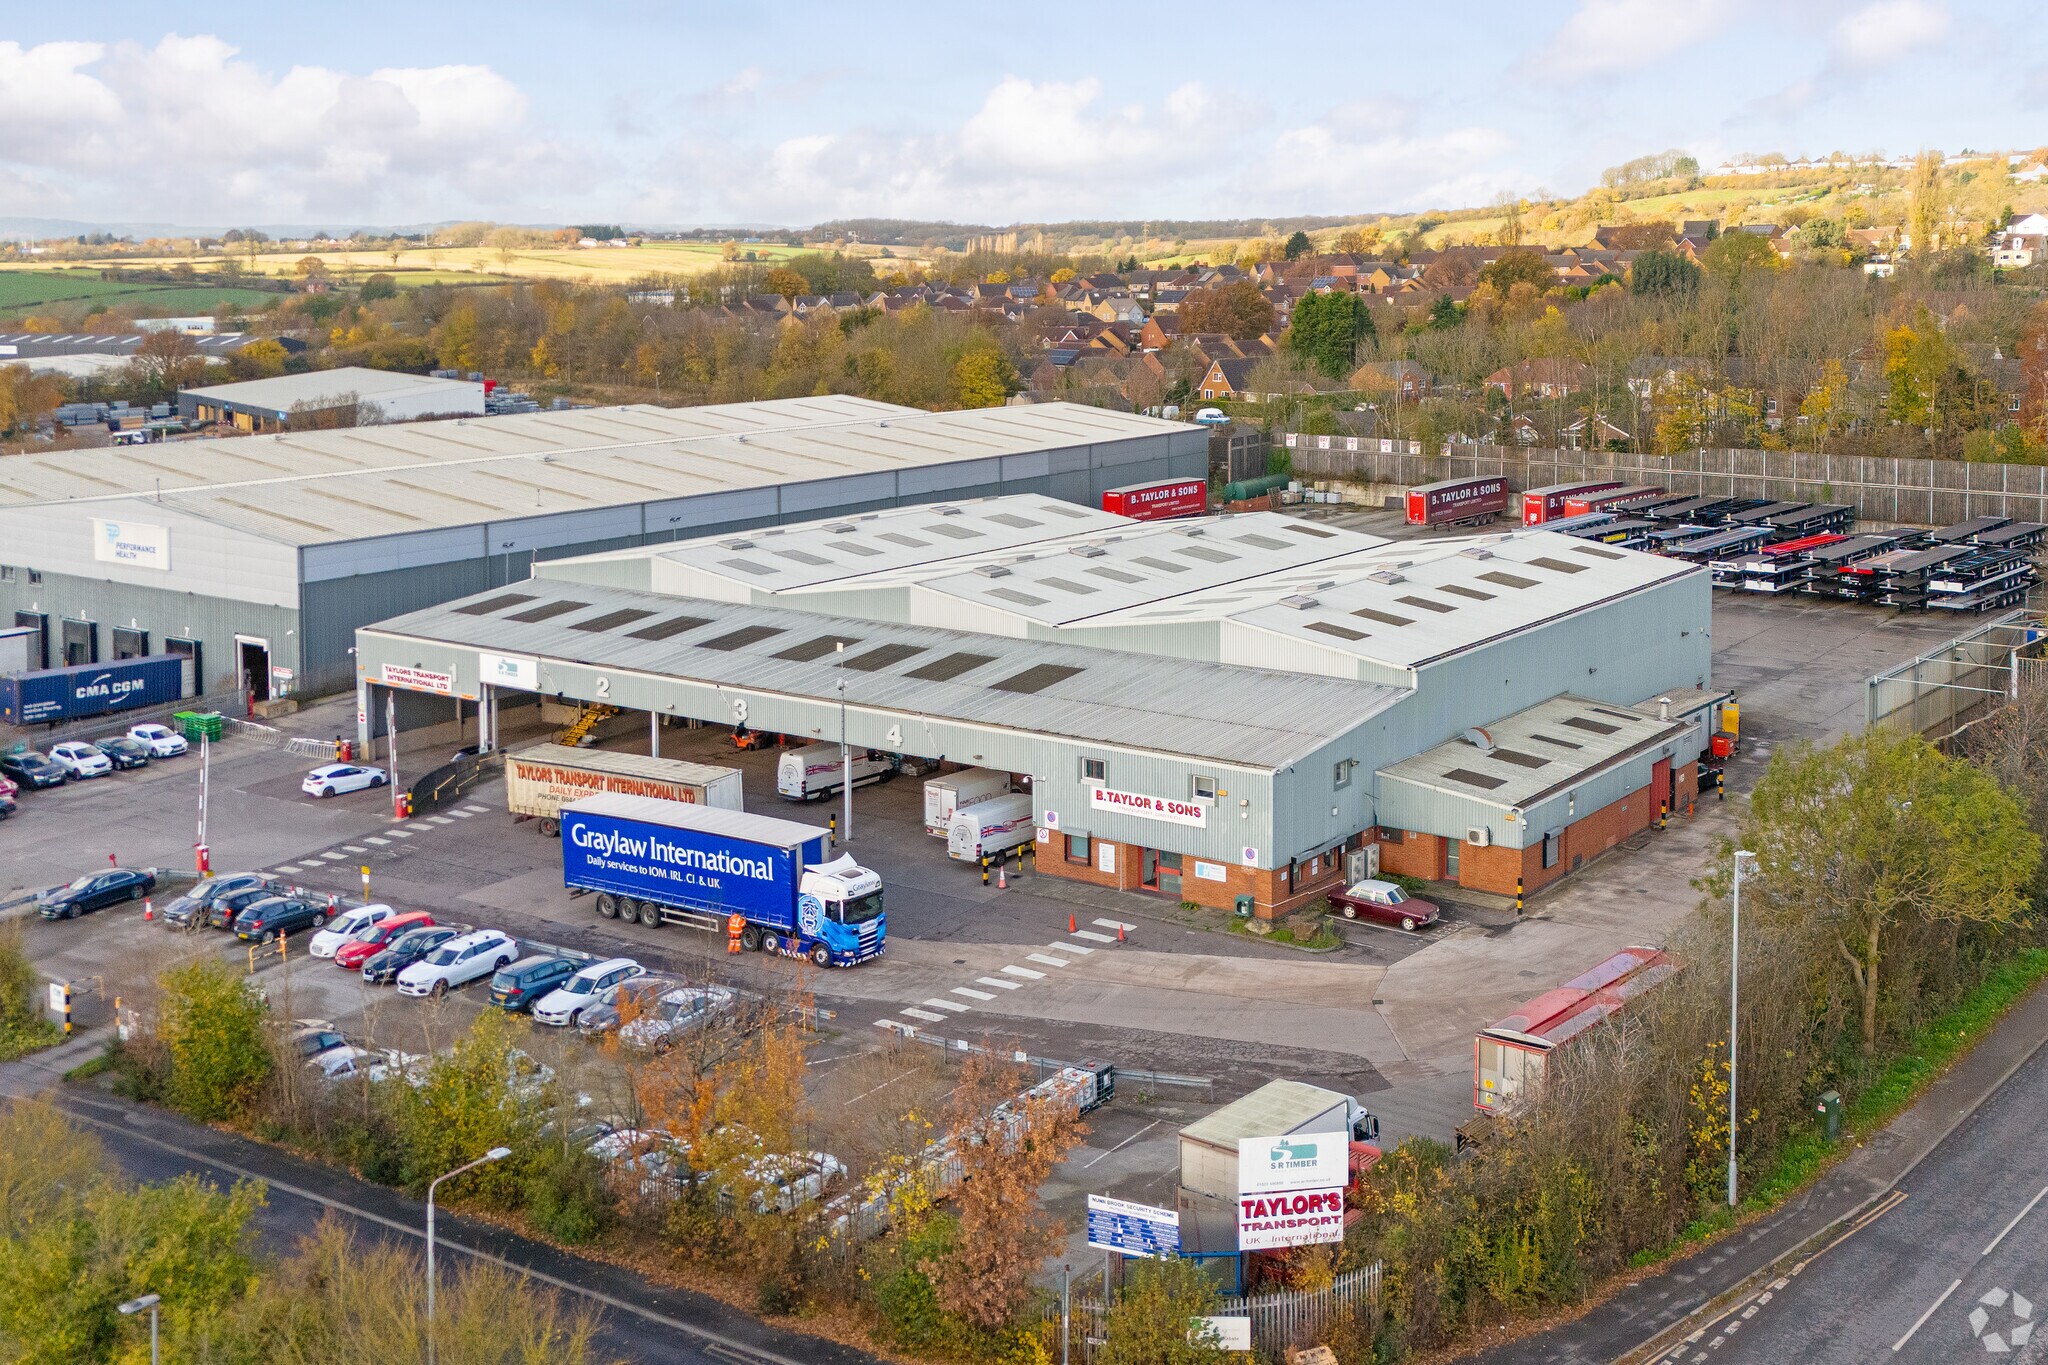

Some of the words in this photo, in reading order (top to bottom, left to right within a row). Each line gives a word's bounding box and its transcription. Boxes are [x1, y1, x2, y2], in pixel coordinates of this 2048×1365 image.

[1131, 495, 1139, 504] B.
[1141, 490, 1169, 502] TAYLOR
[1171, 488, 1176, 497] &
[1178, 485, 1198, 496] SONS
[1432, 495, 1439, 505] B.
[1441, 490, 1471, 503] TAYLOR
[1473, 487, 1478, 497] &
[1480, 483, 1501, 495] SONS
[115, 551, 137, 559] HEALTH
[116, 542, 156, 554] PERFORMANCE
[32, 601, 39, 611] 4
[80, 609, 87, 620] 5
[131, 617, 138, 628] 6
[183, 626, 190, 637] 7
[385, 666, 412, 676] TAYLORS
[413, 671, 449, 682] TRANSPORT
[449, 662, 457, 683] 1
[76, 683, 110, 699] CMA
[112, 679, 144, 693] CGM
[387, 674, 435, 688] INTERNATIONAL
[596, 676, 611, 698] 2
[733, 699, 748, 721] 3
[886, 724, 903, 747] 4
[516, 764, 553, 784] TAYLORS
[554, 769, 605, 791] TRANSPORT
[606, 777, 677, 802] INTERNATIONAL
[678, 790, 696, 804] LTD
[549, 785, 572, 796] DAILY
[538, 793, 560, 801] PHONE
[1095, 789, 1152, 810] B.TAYLOR
[1155, 800, 1164, 811] &
[1168, 802, 1201, 818] SONS
[571, 822, 647, 858] Graylaw
[650, 836, 774, 881] International
[586, 854, 606, 869] Daily
[607, 862, 638, 873] services
[639, 865, 648, 875] to
[698, 875, 707, 887] &
[852, 880, 876, 892] Graylaw
[1270, 1162, 1276, 1170] S
[1278, 1161, 1284, 1169] R
[1285, 1159, 1317, 1169] TIMBER
[1126, 1203, 1151, 1213] SECURITY
[1152, 1209, 1175, 1218] SCHEME
[1241, 1192, 1342, 1219] TAYLOR'S
[1241, 1215, 1342, 1232] TRANSPORT
[1245, 1237, 1261, 1245] UK
[1271, 1229, 1339, 1243] International
